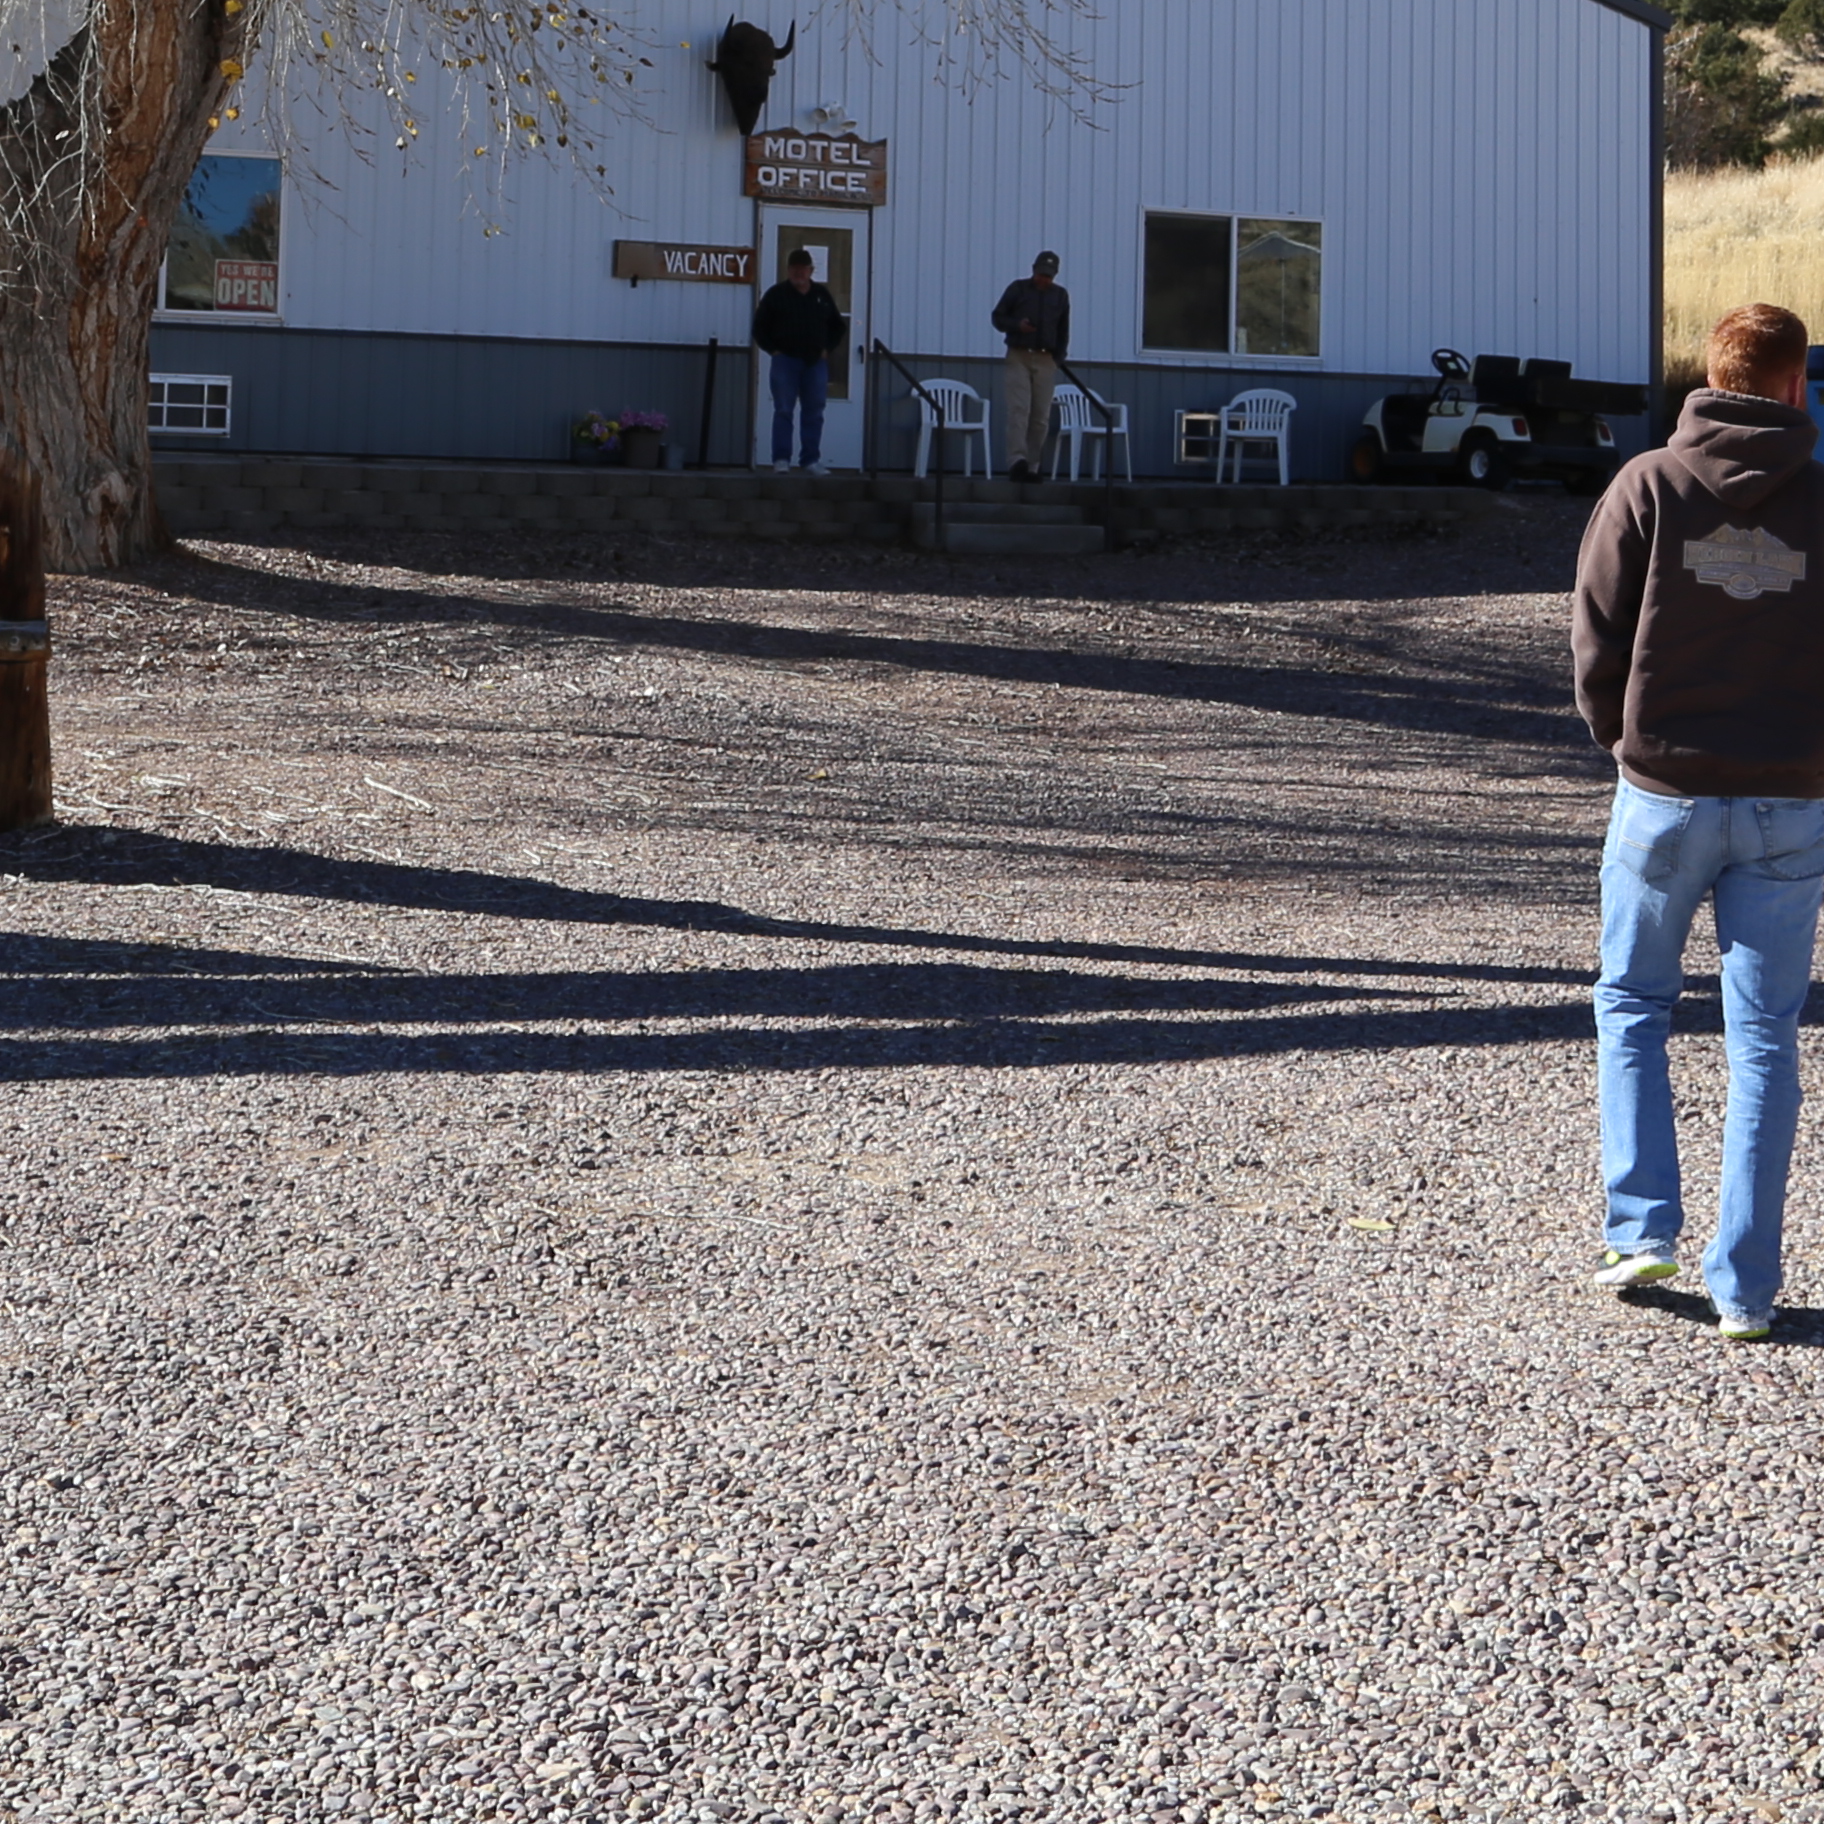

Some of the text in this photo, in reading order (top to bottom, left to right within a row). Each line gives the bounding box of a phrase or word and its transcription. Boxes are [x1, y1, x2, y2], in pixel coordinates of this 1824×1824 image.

[764, 137, 871, 166] MOTEL
[757, 166, 867, 193] OFFICE
[221, 264, 239, 276] YES
[663, 250, 748, 277] VACANCY
[217, 277, 275, 307] OPEN
